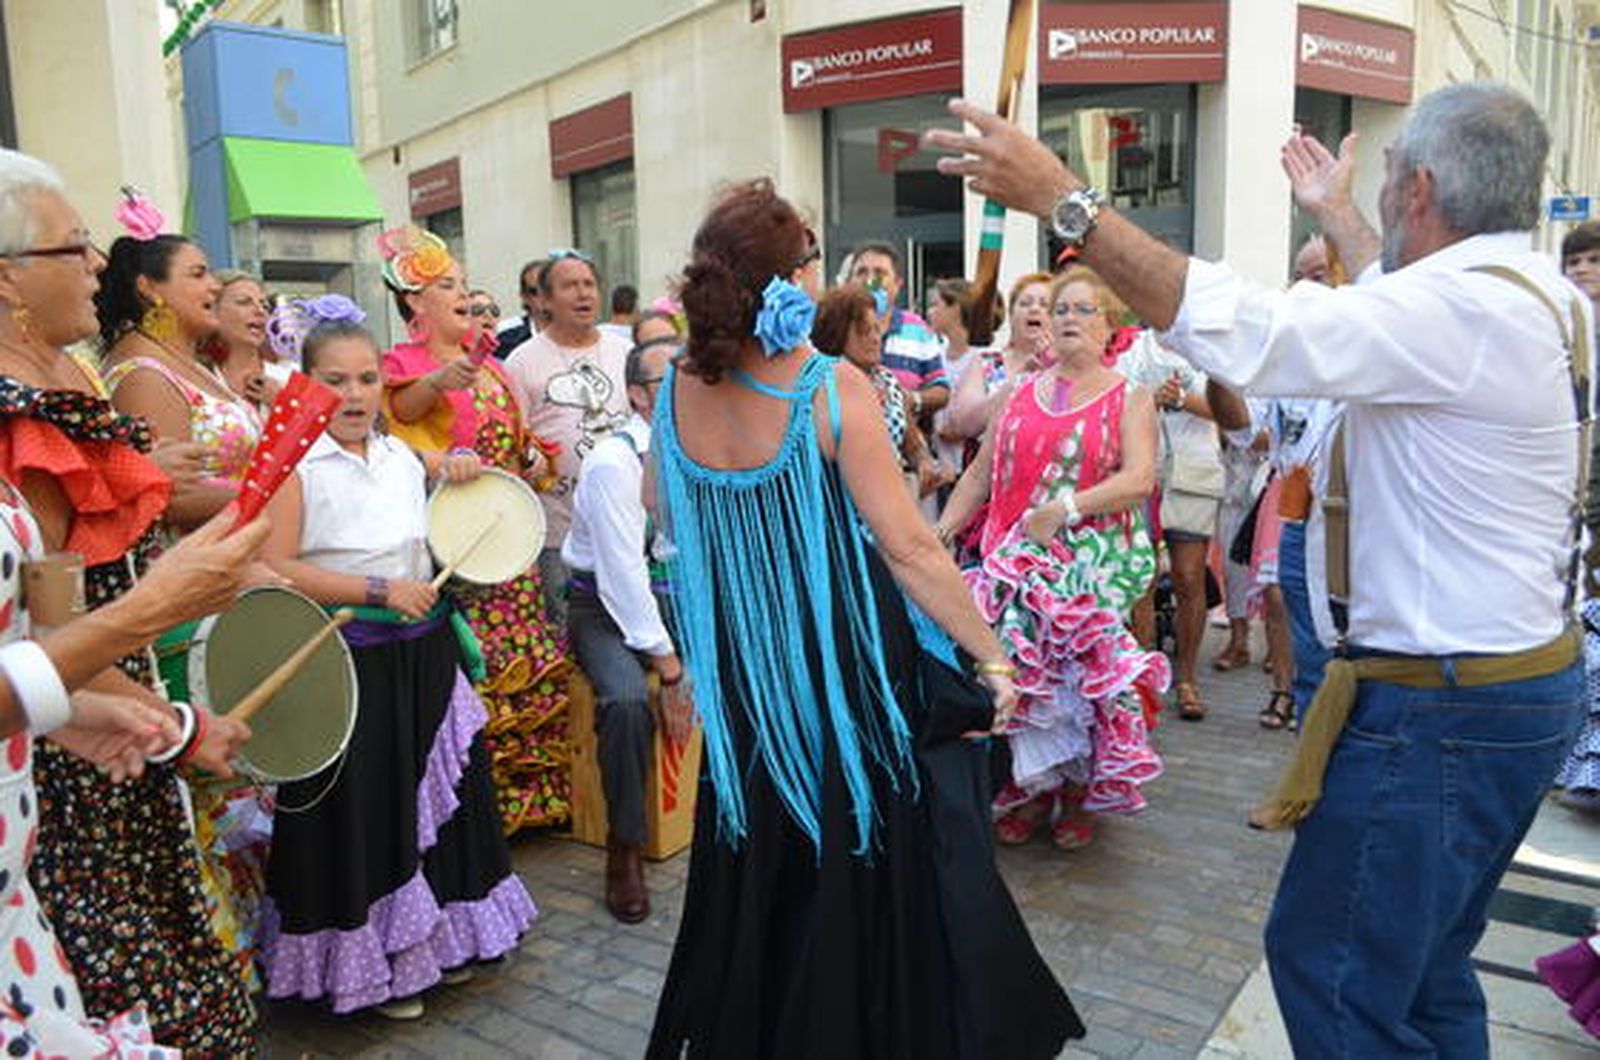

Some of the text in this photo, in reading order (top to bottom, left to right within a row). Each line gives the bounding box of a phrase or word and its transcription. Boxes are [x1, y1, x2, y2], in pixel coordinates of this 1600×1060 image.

[1077, 27, 1216, 44] BANCO POPULAR
[813, 38, 933, 69] BANCO POPULAR
[1354, 45, 1397, 63] POPULAR
